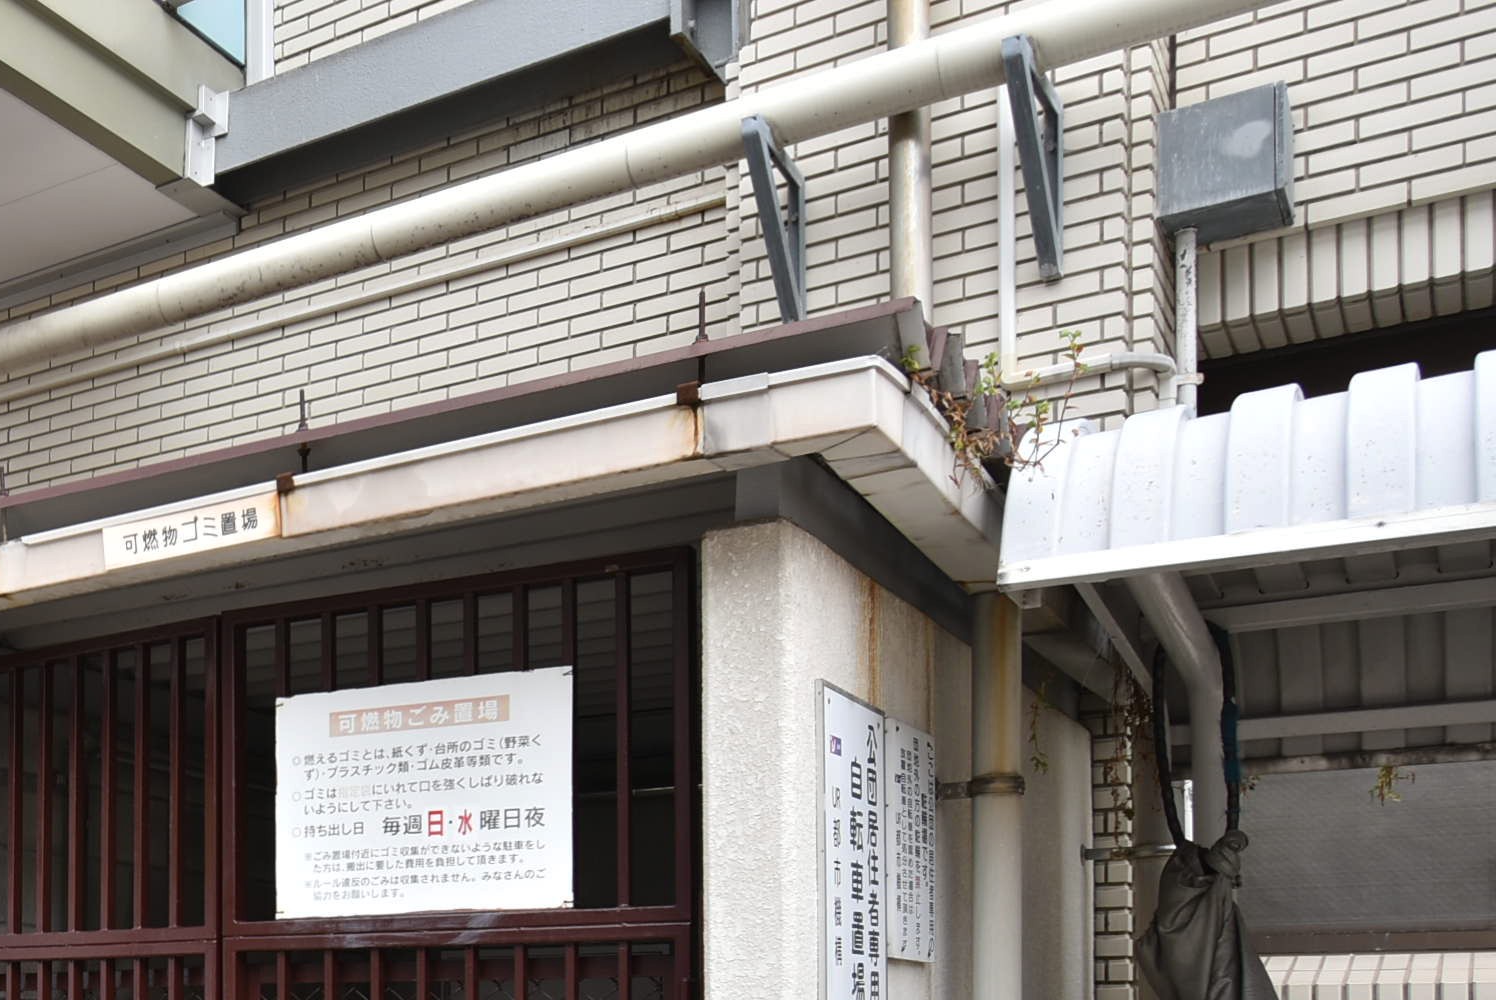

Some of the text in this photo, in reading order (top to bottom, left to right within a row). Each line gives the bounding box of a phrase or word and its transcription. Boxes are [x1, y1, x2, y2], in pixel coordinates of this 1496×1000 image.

[122, 507, 259, 555] 可燃物ゴミ置場
[338, 700, 499, 733] 可燃物ごみ置場
[304, 798, 412, 815] いようにして下さい。
[304, 822, 365, 838] 持ち出し日
